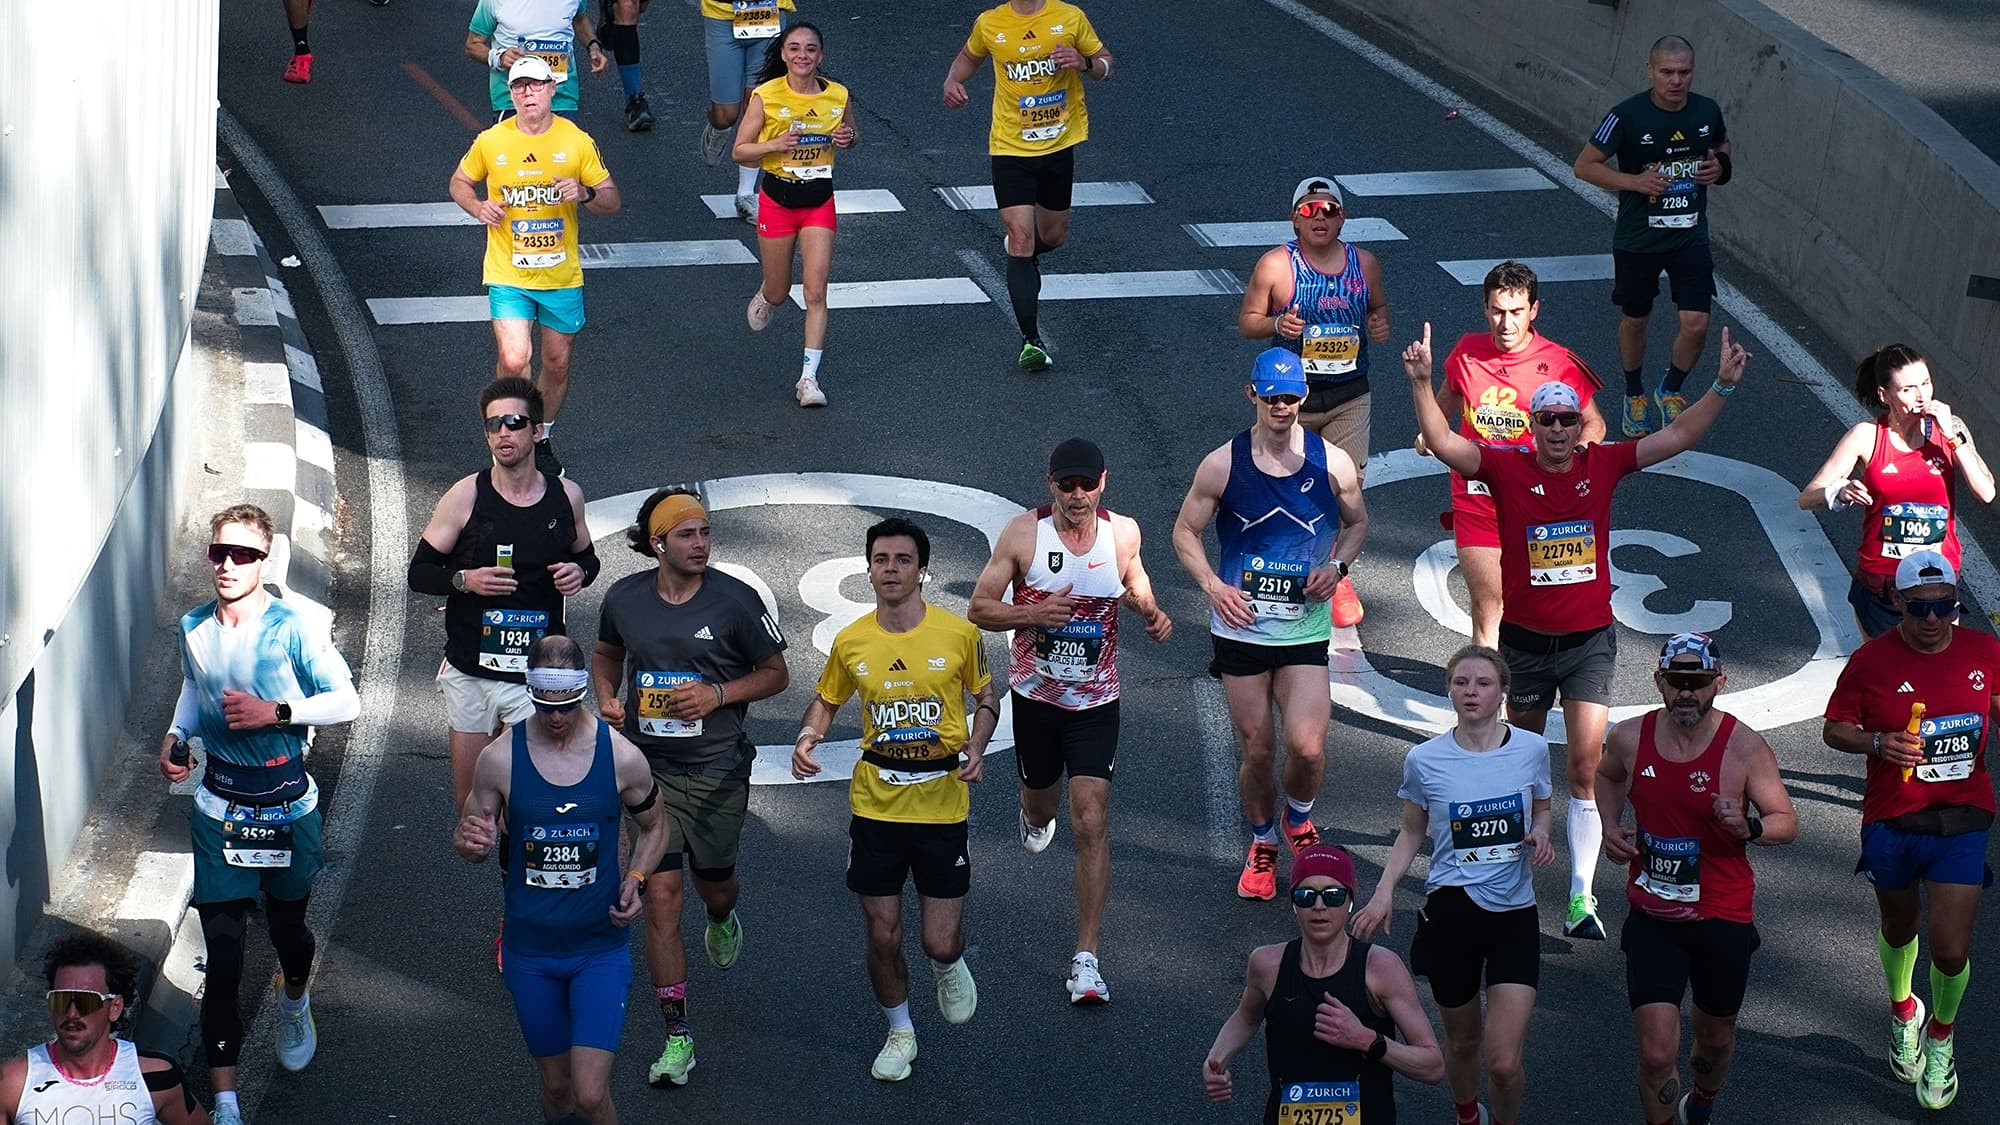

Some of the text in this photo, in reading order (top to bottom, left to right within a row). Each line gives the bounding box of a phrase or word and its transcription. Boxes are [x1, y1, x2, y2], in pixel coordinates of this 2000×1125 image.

[1007, 58, 1057, 82] MADRI
[1038, 93, 1063, 105] ZURICH
[1031, 107, 1060, 121] 25406
[791, 148, 821, 161] 22257
[501, 185, 563, 208] MADRID
[1662, 196, 1689, 210] 2286
[531, 221, 559, 230] ZURICH
[523, 235, 556, 248] 23533
[1324, 326, 1354, 335] ZURICH
[1314, 341, 1349, 353] 25325
[1480, 386, 1518, 406] 42
[1476, 415, 1525, 429] MADRID
[1490, 433, 1508, 441] 2016
[1551, 525, 1588, 537] ZURICH
[1900, 521, 1931, 537] 1906
[1542, 543, 1583, 561] 22794
[1267, 561, 1303, 573] ZURICH
[1258, 577, 1291, 594] 2519
[1062, 625, 1096, 634] ZURICH
[500, 631, 530, 646] 1934
[1052, 640, 1086, 657] 3206
[870, 700, 941, 729] MADRID
[1940, 716, 1977, 730] ZURICH
[895, 731, 931, 742] ZURICH
[1934, 735, 1969, 755] 2788
[1476, 799, 1517, 813] ZURICH
[250, 811, 286, 821] RICH
[240, 826, 276, 841] 3532
[551, 828, 591, 838] ZURICH
[1471, 818, 1508, 838] 3270
[543, 846, 580, 862] 2384
[1650, 854, 1682, 875] 1897
[1306, 1087, 1351, 1098] ZURICH
[1293, 1108, 1344, 1125] 23725
